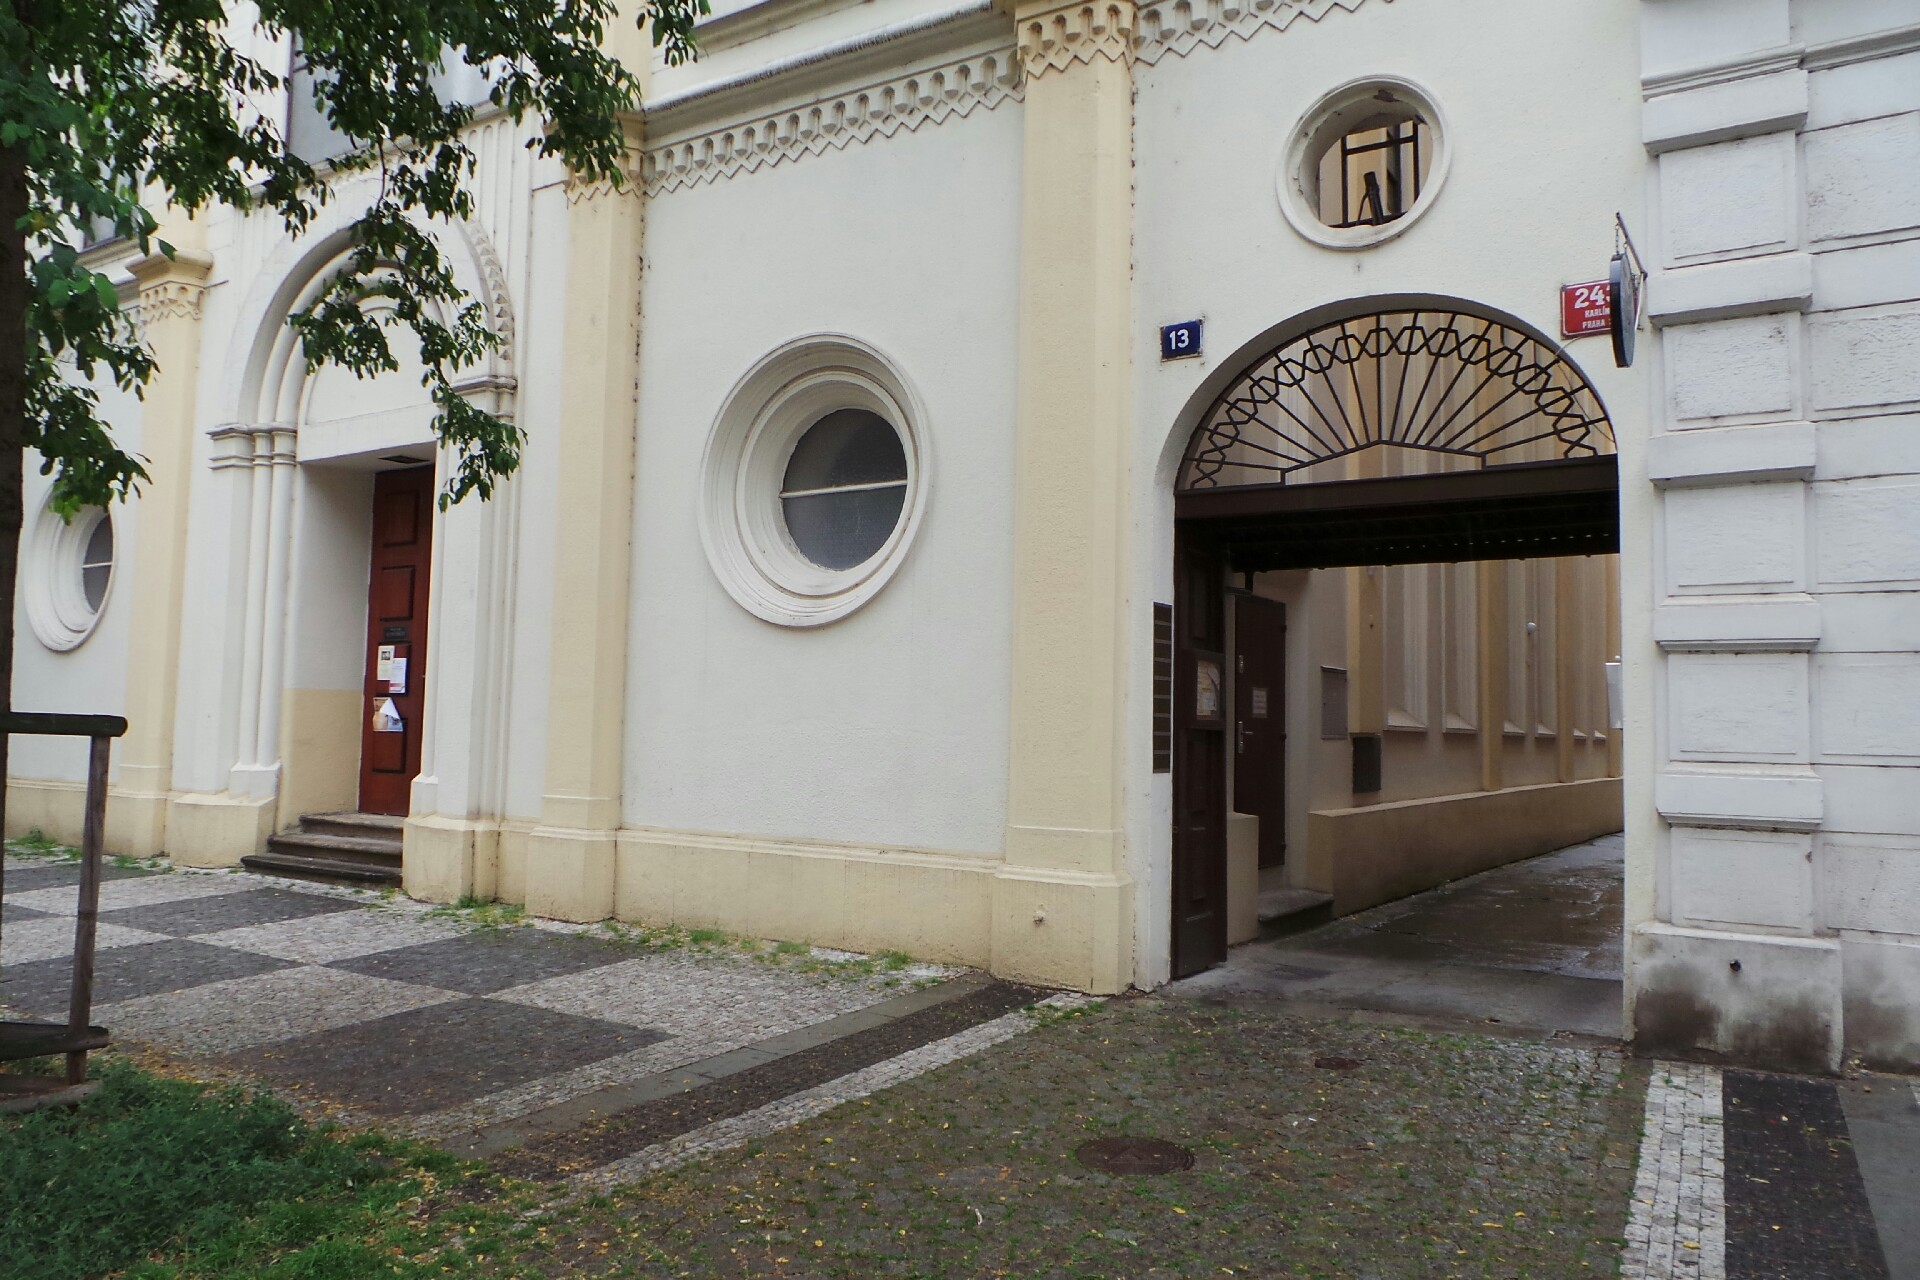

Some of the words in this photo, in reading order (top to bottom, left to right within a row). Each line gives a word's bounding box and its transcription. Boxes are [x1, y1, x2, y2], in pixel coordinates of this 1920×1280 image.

[1574, 285, 1610, 309] 24
[1582, 319, 1605, 329] PRAHA
[1169, 328, 1189, 350] 13
